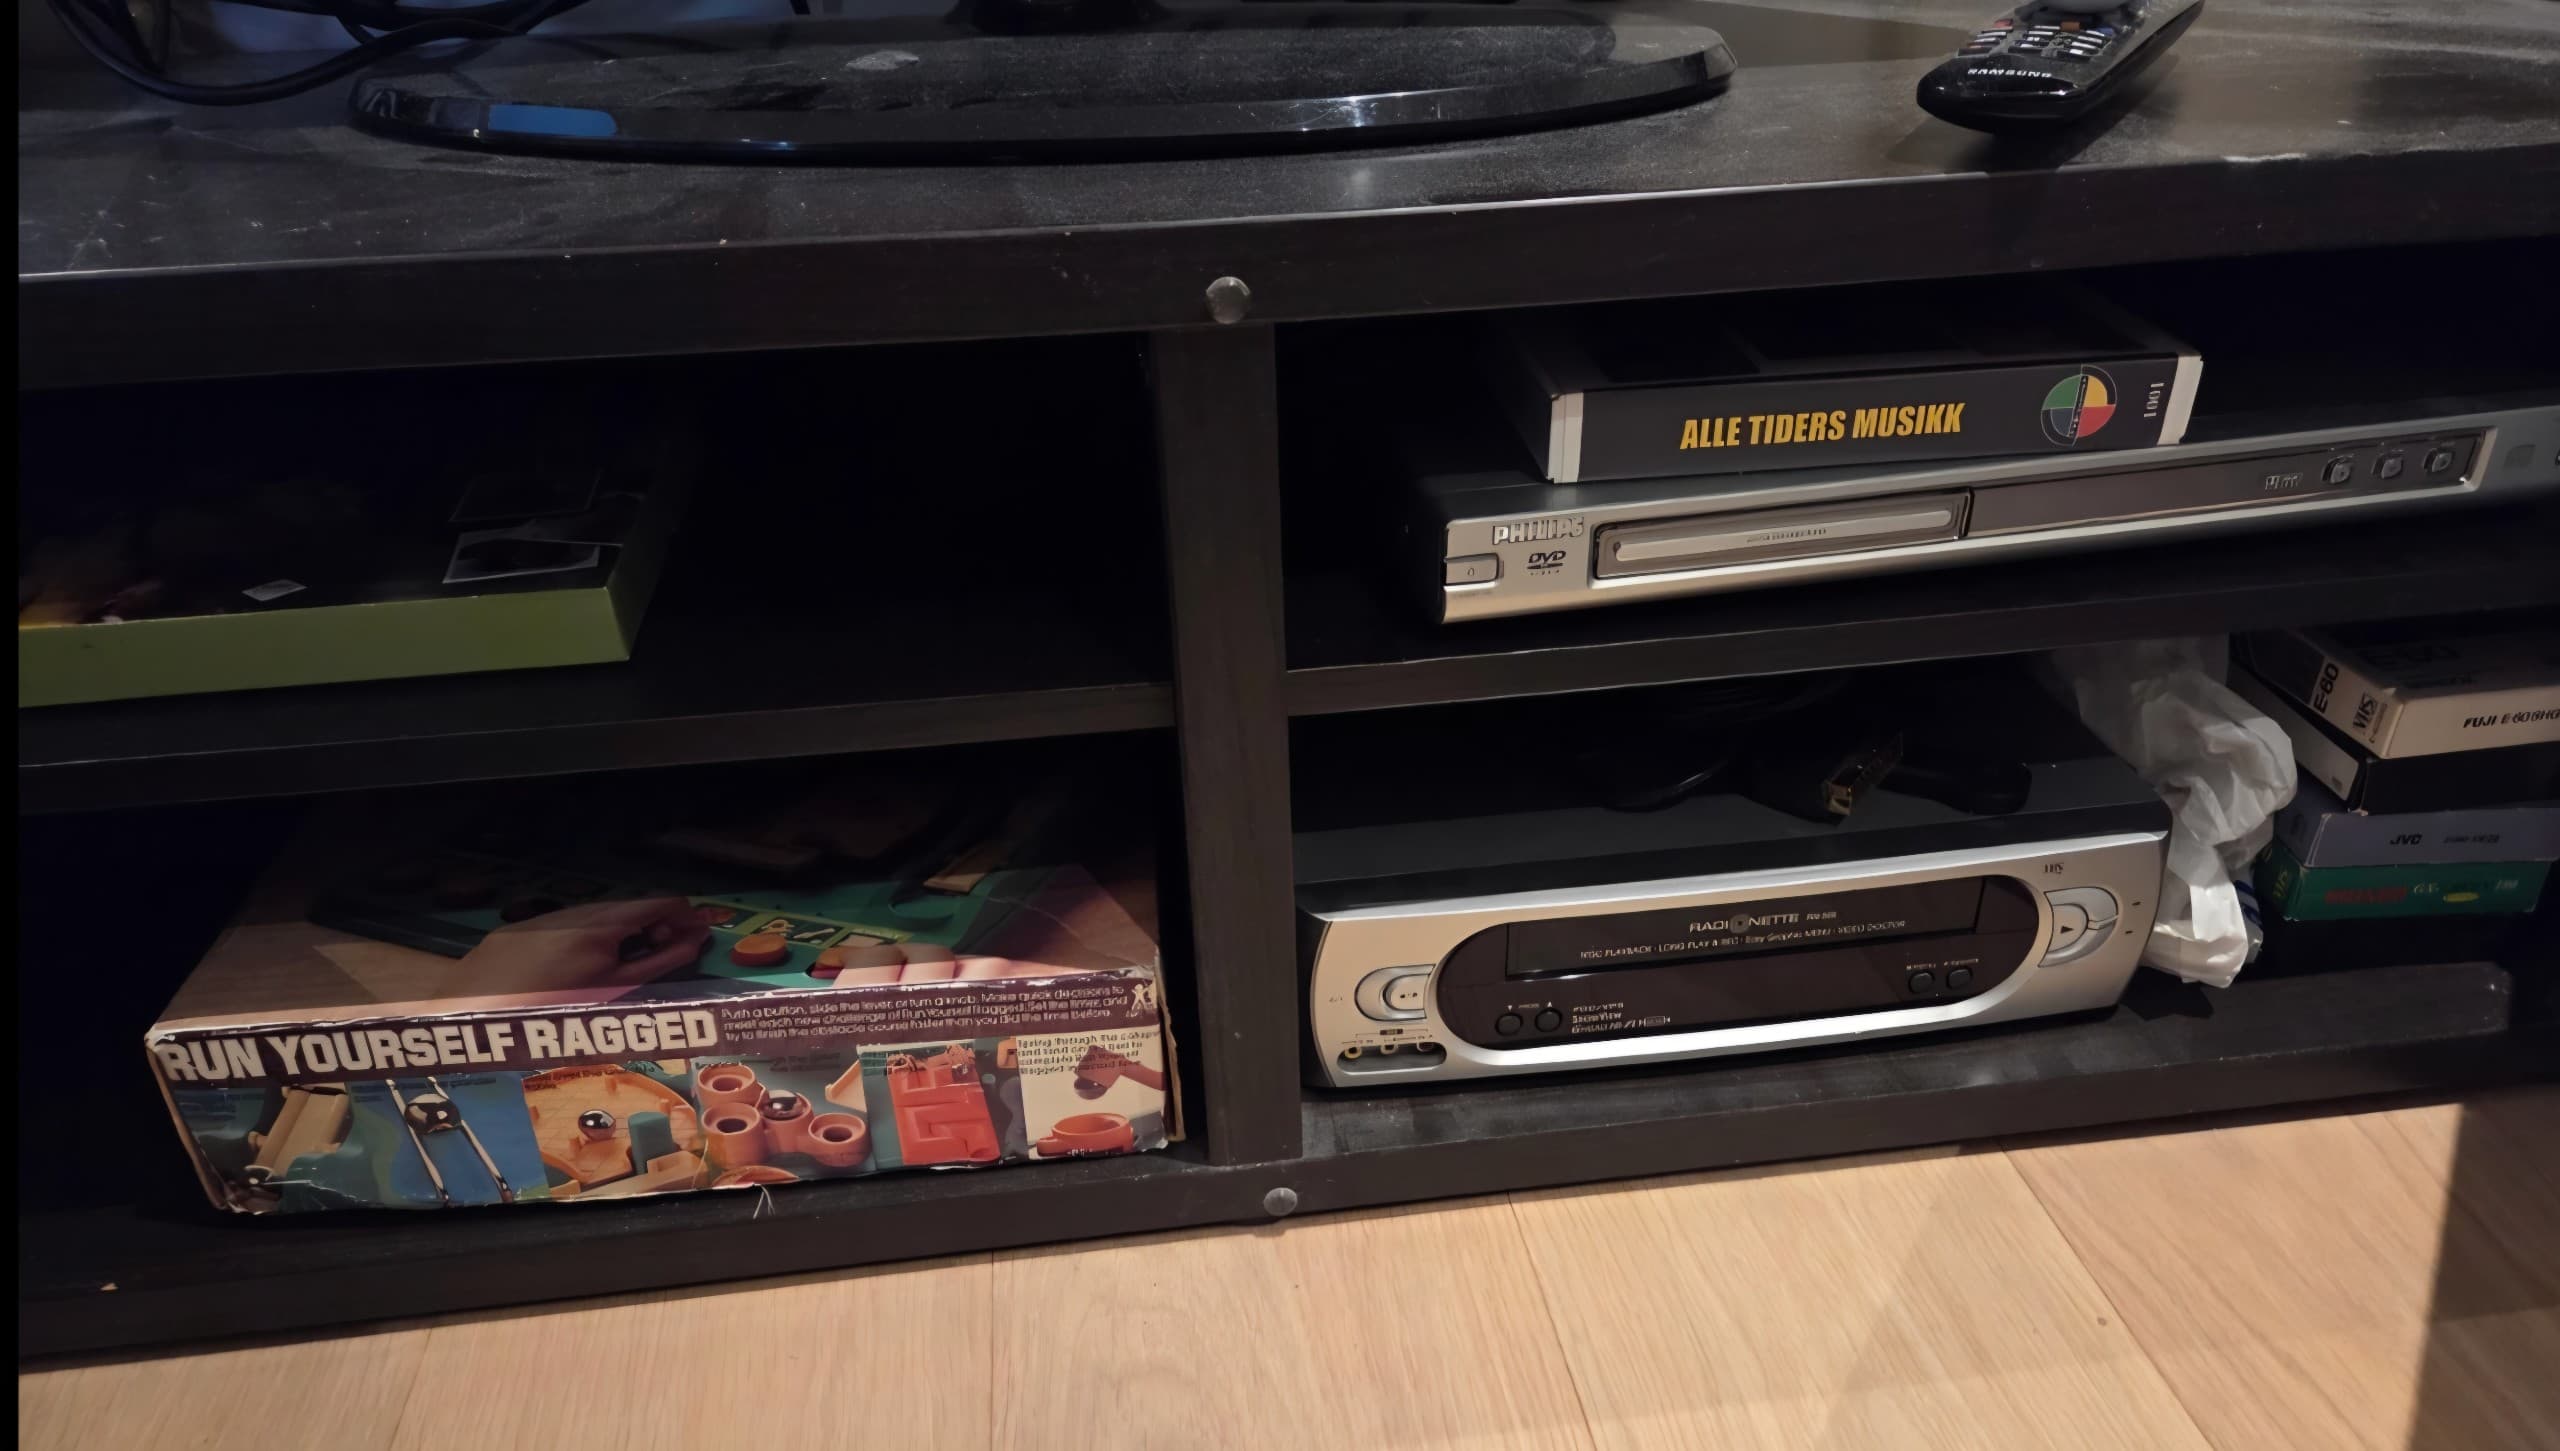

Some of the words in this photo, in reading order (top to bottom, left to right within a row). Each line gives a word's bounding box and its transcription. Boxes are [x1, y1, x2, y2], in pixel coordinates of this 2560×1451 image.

[1680, 418, 1741, 450] ALLE
[1748, 409, 1846, 445] TIDERS
[1851, 402, 1966, 439] MUSIKK
[1492, 517, 1584, 545] PHILIPS
[1528, 551, 1566, 564] DVD
[2313, 663, 2339, 713] E-60
[2353, 692, 2378, 728] VHS
[2463, 715, 2497, 728] FUJI
[2390, 834, 2423, 845] JVC
[752, 1010, 762, 1018] a
[840, 1002, 860, 1011] the
[934, 998, 943, 1006] a
[1112, 986, 1124, 995] to
[1103, 996, 1127, 1007] and
[975, 1016, 997, 1026] you
[165, 1036, 270, 1083] RUN
[267, 1020, 517, 1077] YOURSELF
[523, 1009, 718, 1060] RAGGED
